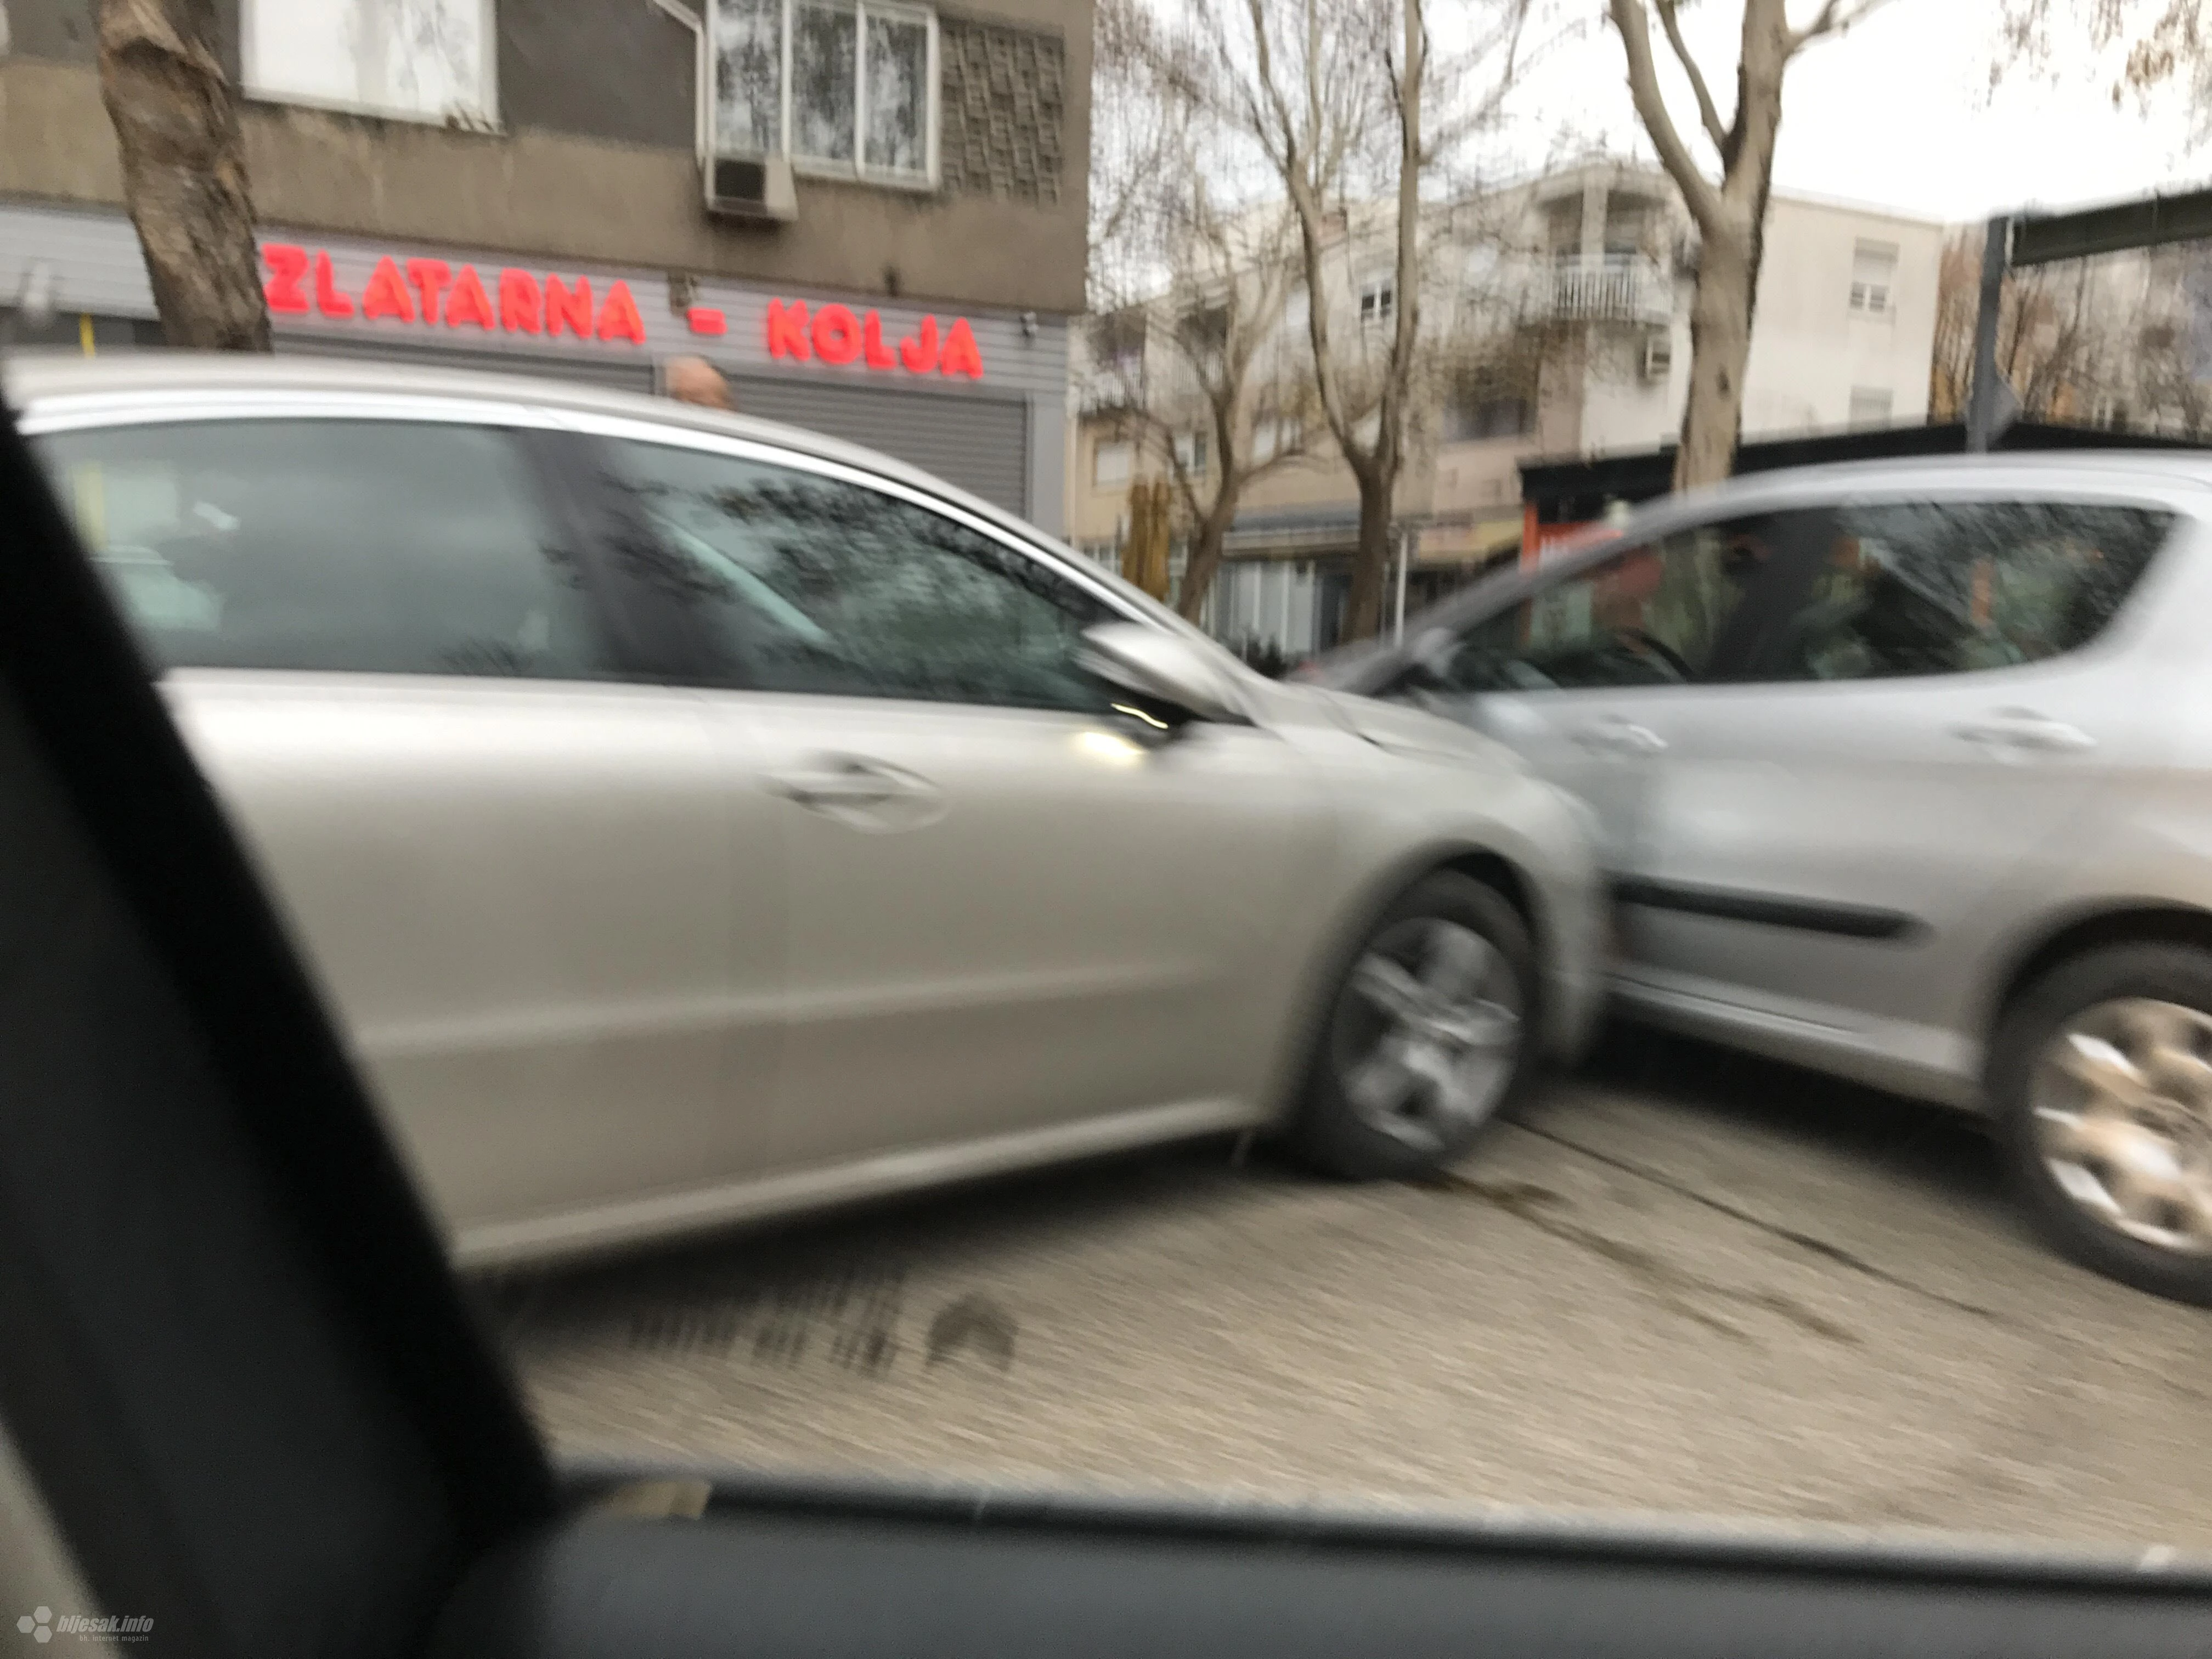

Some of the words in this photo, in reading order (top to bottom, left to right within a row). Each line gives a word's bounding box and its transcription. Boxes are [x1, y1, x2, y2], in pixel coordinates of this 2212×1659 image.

[261, 243, 646, 345] ZLATARNA
[687, 307, 727, 335] -
[765, 297, 983, 379] KOLJA
